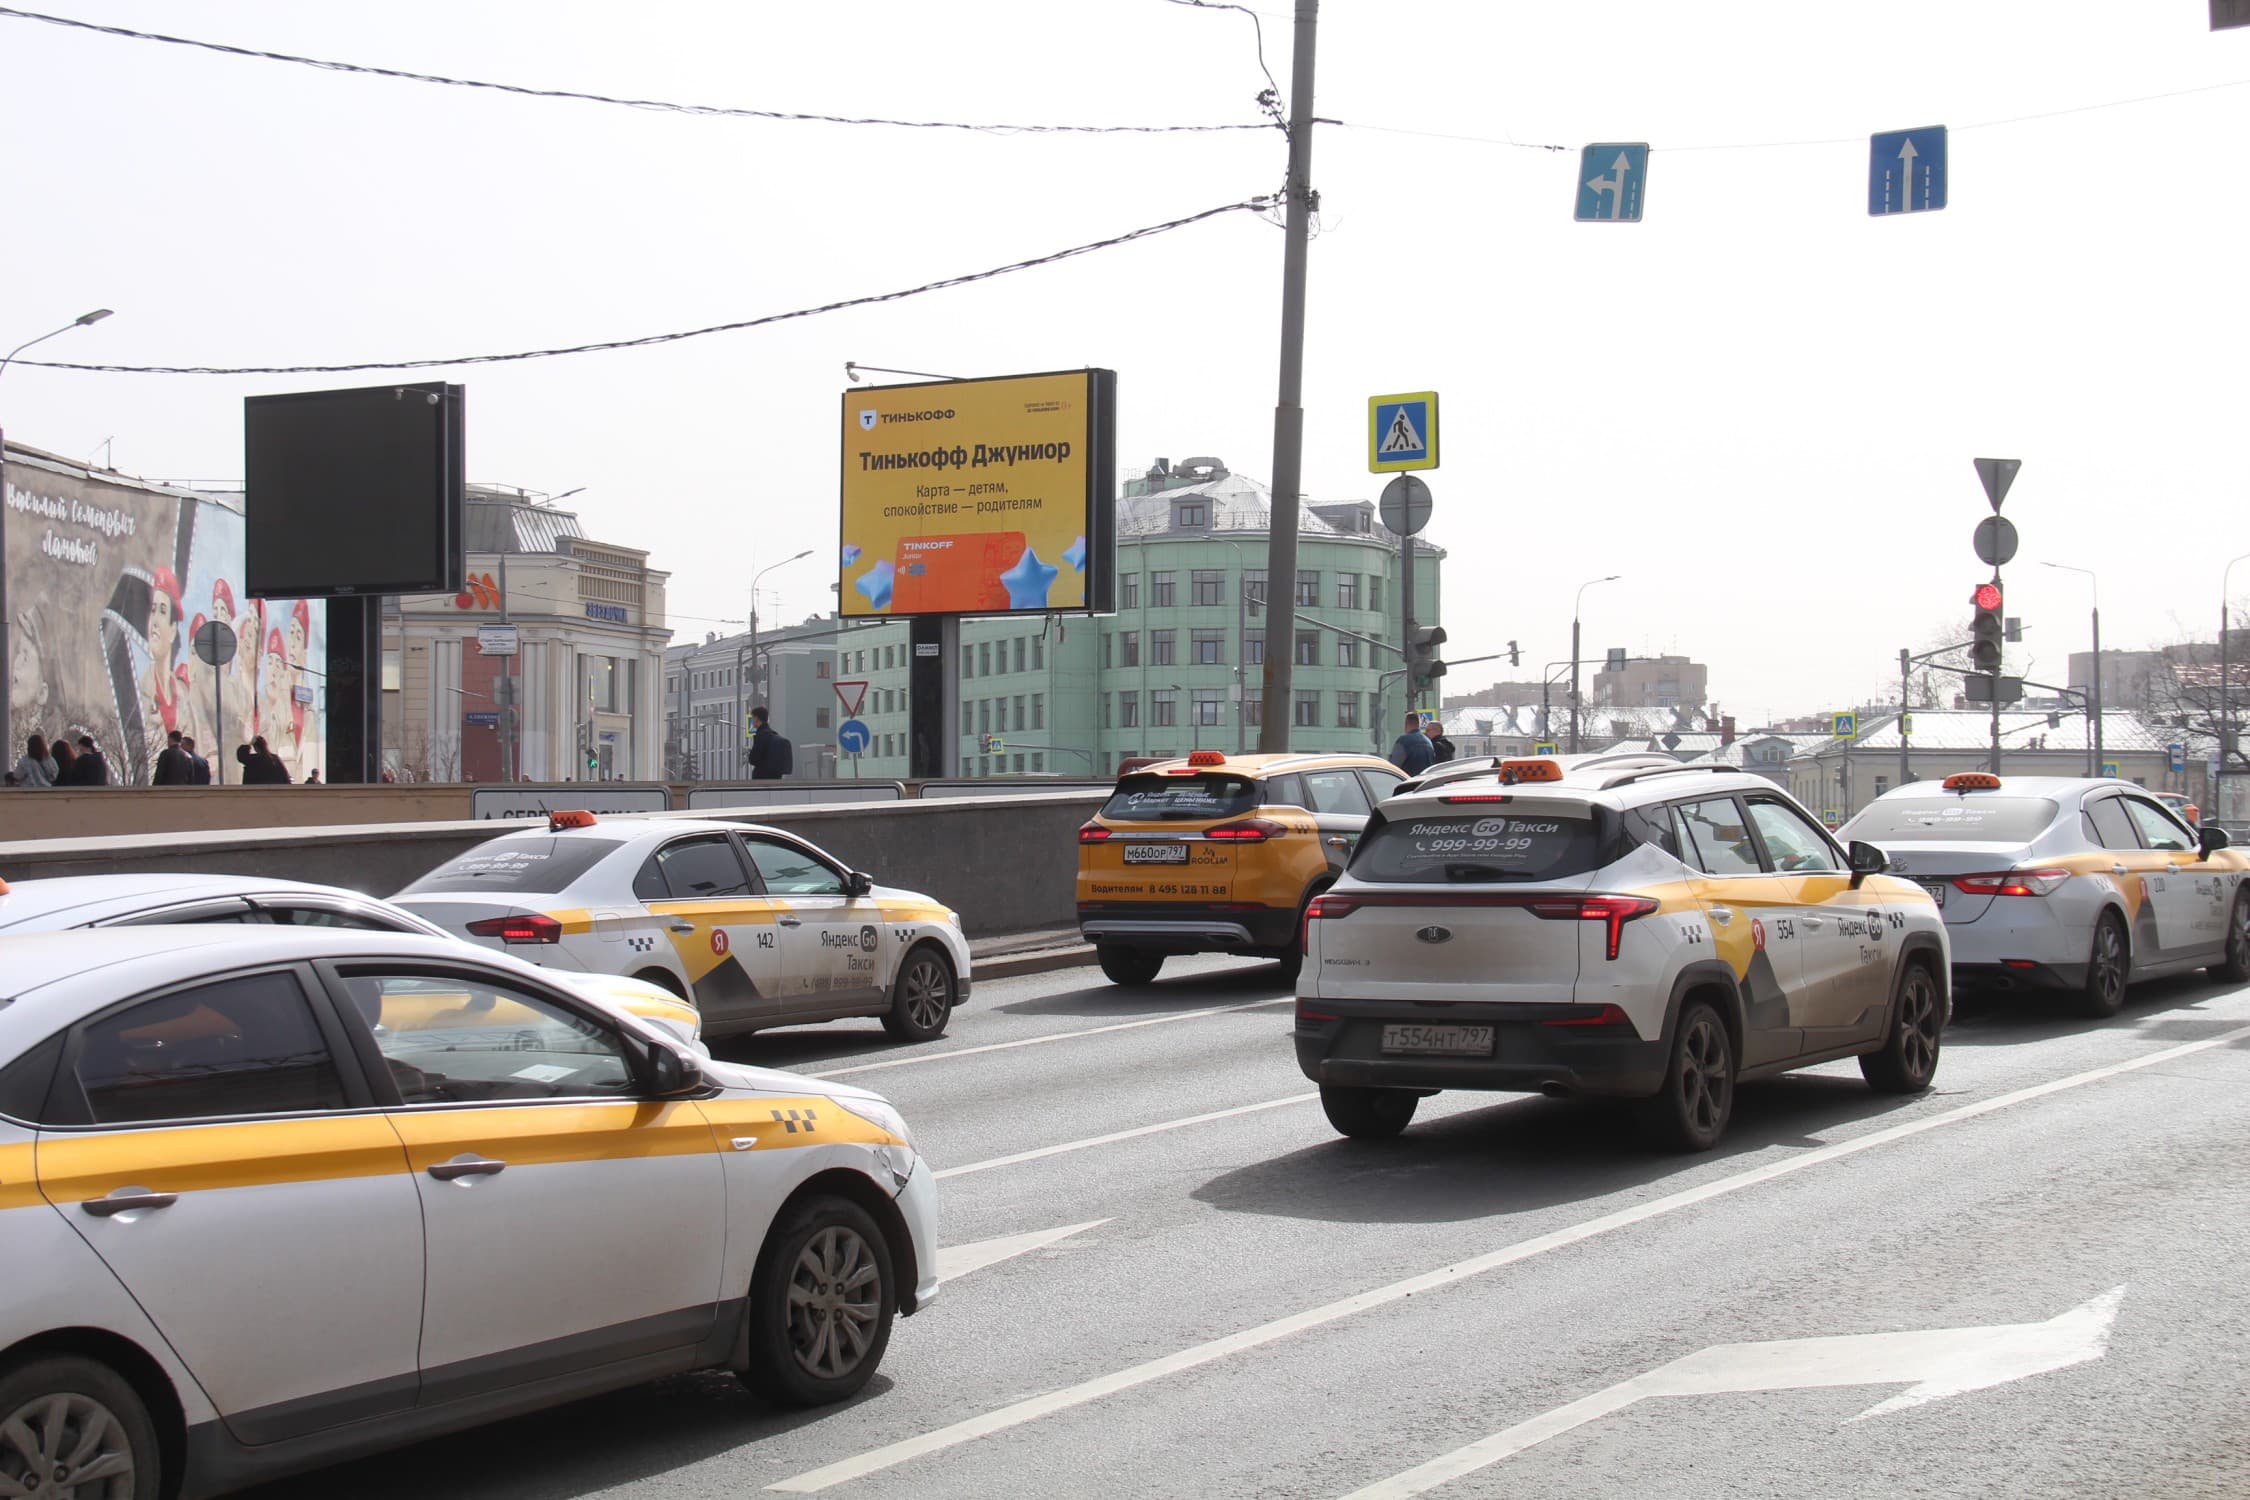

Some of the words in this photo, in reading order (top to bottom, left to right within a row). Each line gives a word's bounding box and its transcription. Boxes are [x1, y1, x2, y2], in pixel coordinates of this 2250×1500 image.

[881, 409, 955, 424] ТИНЬКОФФ
[859, 446, 968, 471] Тинькофф
[971, 441, 1071, 467] Джуниор
[916, 485, 950, 500] Карта
[968, 482, 1009, 496] детям,
[883, 502, 958, 517] спокойствие
[976, 498, 1043, 515] родителям
[903, 541, 954, 551] TINKOFF
[1409, 823, 1471, 836] Яндекс
[1474, 819, 1503, 835] Go
[1508, 821, 1559, 833] Такси
[1429, 837, 1532, 852] 999-99-99
[1091, 883, 1143, 894] Водителям
[1158, 884, 1178, 894] 495
[1200, 886, 1209, 894] 11
[1777, 920, 1794, 940] 554
[1838, 917, 1868, 938] Яндекс
[715, 934, 724, 951] Я
[757, 932, 774, 949] 142
[821, 930, 858, 949] Яндекс
[862, 928, 877, 947] Go
[847, 954, 874, 971] Такси
[1388, 1028, 1457, 1048] Т554НТ
[1461, 1028, 1489, 1043] 797
